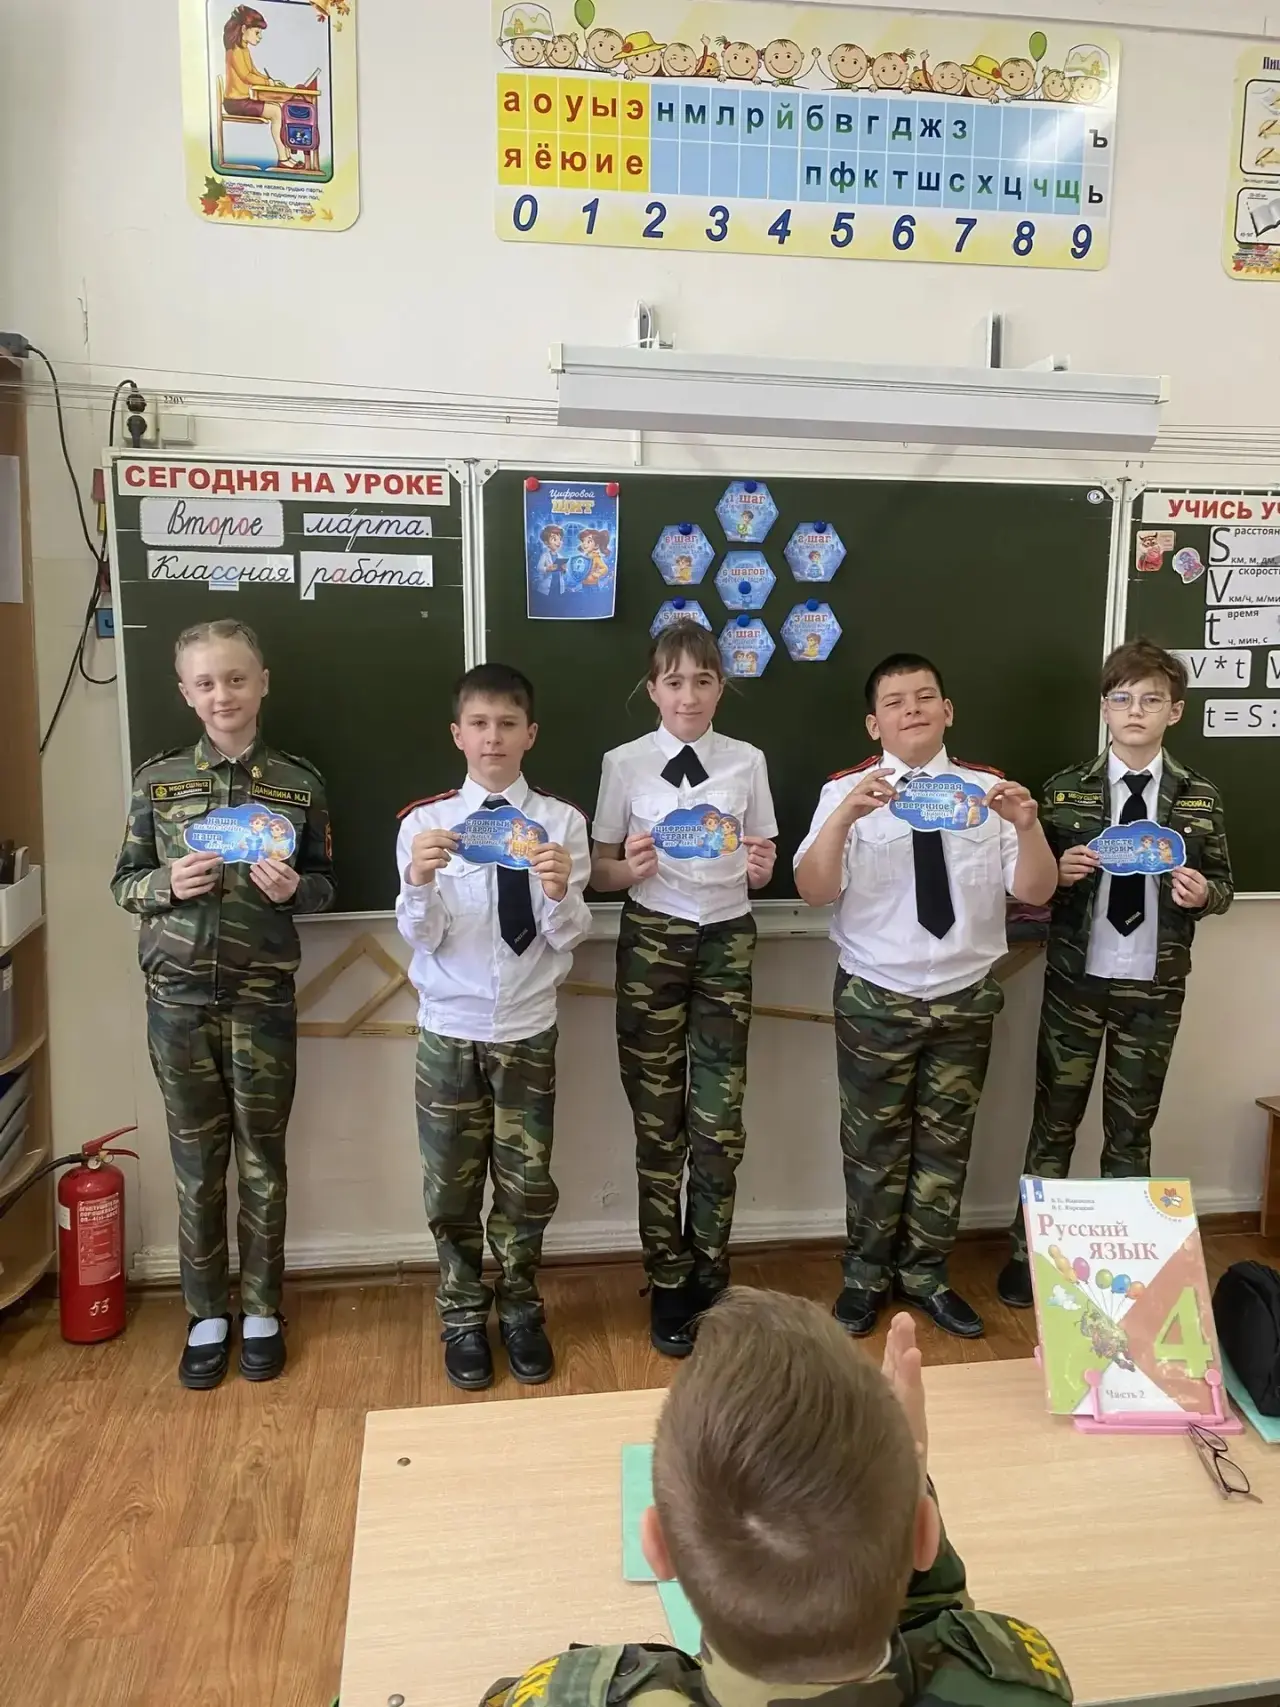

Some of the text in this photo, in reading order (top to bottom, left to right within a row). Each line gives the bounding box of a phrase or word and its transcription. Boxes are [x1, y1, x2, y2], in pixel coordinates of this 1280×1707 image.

[513, 195, 1092, 259] 0 1 2 3 4 5 6 7 8 9
[124, 465, 444, 496] СЕГОДНЯ НА УРОКЕ
[167, 499, 263, 545] Второе
[1168, 499, 1253, 519] УЧИСЬ
[1210, 527, 1231, 563] S
[152, 553, 292, 582] Классная
[1209, 569, 1233, 603] V
[1229, 594, 1253, 603] км/ч,
[1228, 609, 1259, 620] время
[1206, 613, 1221, 645] t
[1190, 656, 1207, 679] V
[1235, 658, 1245, 679] t
[1206, 706, 1216, 728] t
[1247, 704, 1263, 728] S
[254, 785, 292, 800] ДАНИЛИНА
[1037, 1213, 1129, 1241] Русский
[1089, 1242, 1160, 1261] ЯЗЫК
[1154, 1286, 1214, 1378] 4
[1105, 1389, 1146, 1401] Часть 2
